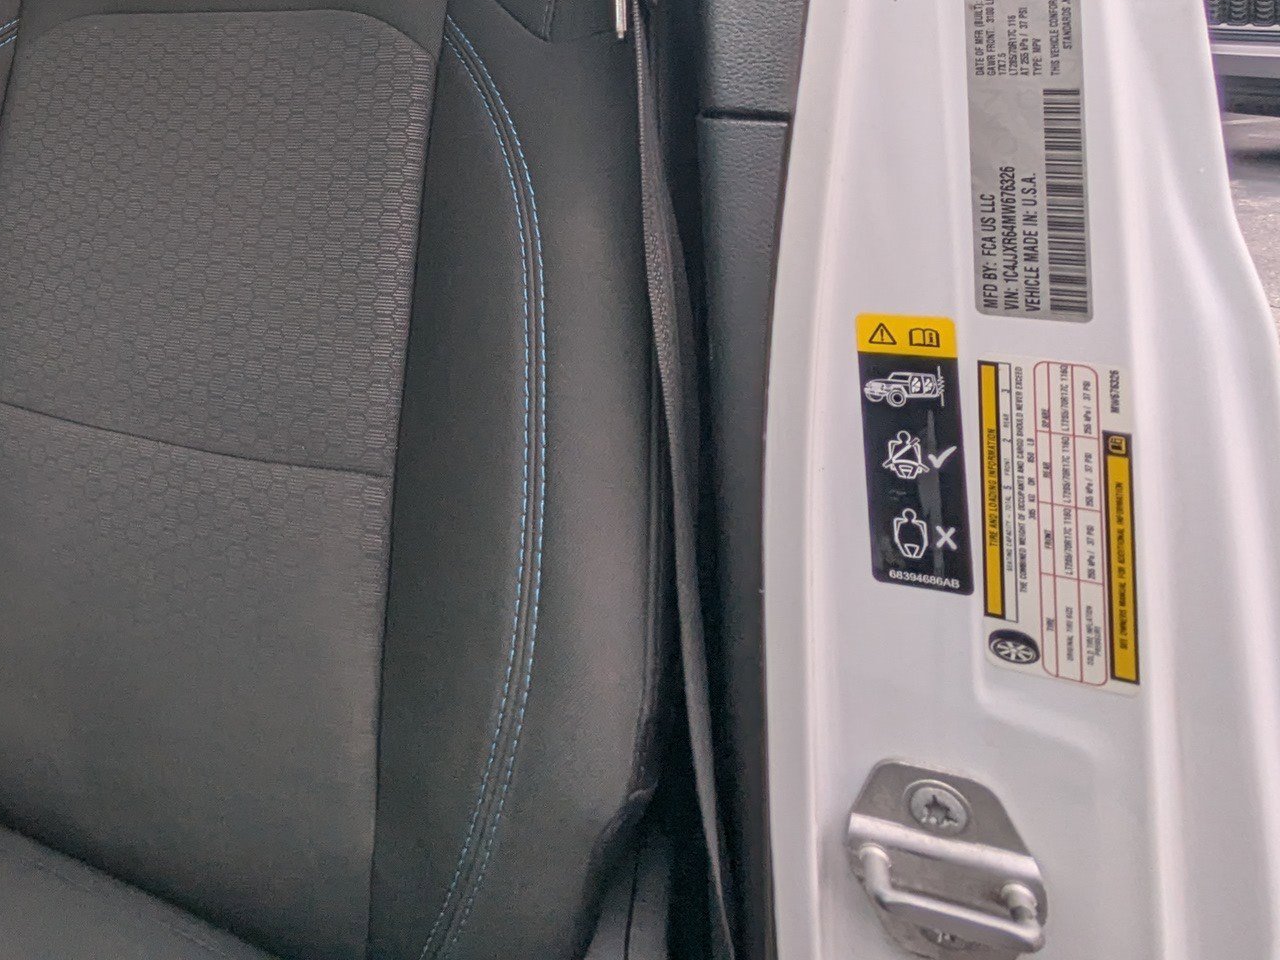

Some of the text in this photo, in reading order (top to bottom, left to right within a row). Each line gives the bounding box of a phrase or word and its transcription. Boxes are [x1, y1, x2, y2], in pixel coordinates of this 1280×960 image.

[1018, 6, 1027, 18] PSI
[1019, 20, 1027, 29] 37
[1061, 7, 1072, 49] STANDARDS
[974, 29, 983, 44] MFR
[1049, 29, 1059, 57] VEHICLE
[975, 46, 984, 55] OF
[975, 58, 984, 75] DATE
[986, 55, 996, 75] GAWR
[1020, 67, 1029, 75] AT
[1050, 60, 1059, 75] THIS
[980, 193, 998, 308] MFD BY: FCA US LLC
[1020, 172, 1040, 311] VEHICLE MADE IN: U.S.A.
[1003, 287, 1019, 310] VIN:
[1014, 365, 1023, 390] EXCEED
[1015, 390, 1023, 411] NEVER
[1015, 412, 1024, 436] SHOULD
[1016, 438, 1024, 459] CARGO
[1016, 460, 1024, 473] AND
[986, 428, 997, 546] TIRE AND LOADING INFORMATION
[1017, 475, 1025, 511] OCCUPANTS
[888, 570, 960, 589] 68394686AB
